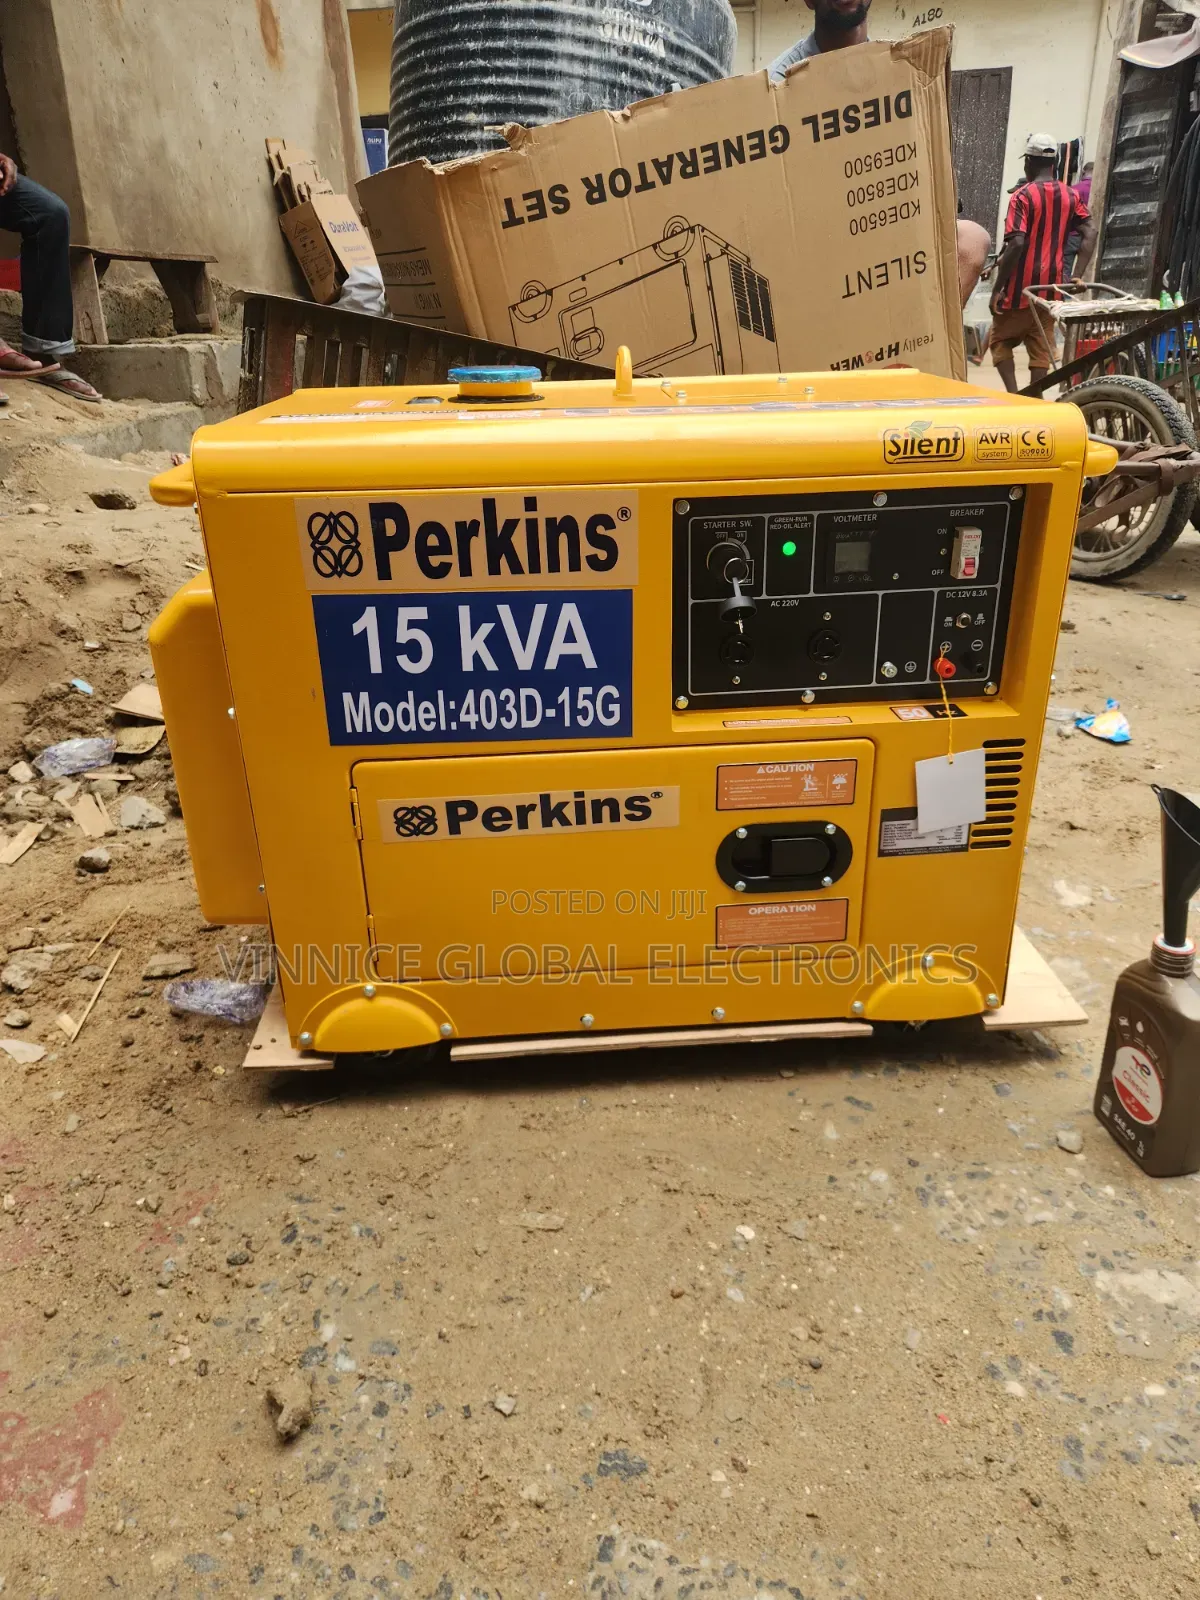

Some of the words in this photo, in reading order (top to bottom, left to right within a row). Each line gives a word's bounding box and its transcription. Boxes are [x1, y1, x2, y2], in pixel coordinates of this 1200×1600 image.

[912, 7, 943, 28] A180
[801, 89, 913, 144] DIESEL
[580, 124, 791, 206] GENERATOR
[843, 141, 918, 179] KDE9500
[846, 169, 920, 208] KDE8500
[500, 182, 572, 230] SET
[848, 198, 921, 236] KDE6500
[328, 221, 359, 234] DuraVolt
[840, 250, 928, 299] SILENT
[902, 333, 934, 352] really
[887, 431, 961, 457] Silent
[978, 432, 1010, 445] AVR
[833, 514, 877, 523] VOLTMETER
[950, 508, 985, 516] BREAKER
[703, 521, 736, 529] STARTER
[770, 600, 781, 608] AC
[946, 591, 957, 599] DC
[351, 605, 435, 675] 15
[457, 602, 599, 672] kVA
[341, 685, 622, 734] Model:403D-15G
[897, 707, 929, 719] 50
[765, 763, 815, 774] CAUTION
[748, 904, 817, 915] OPERATION
